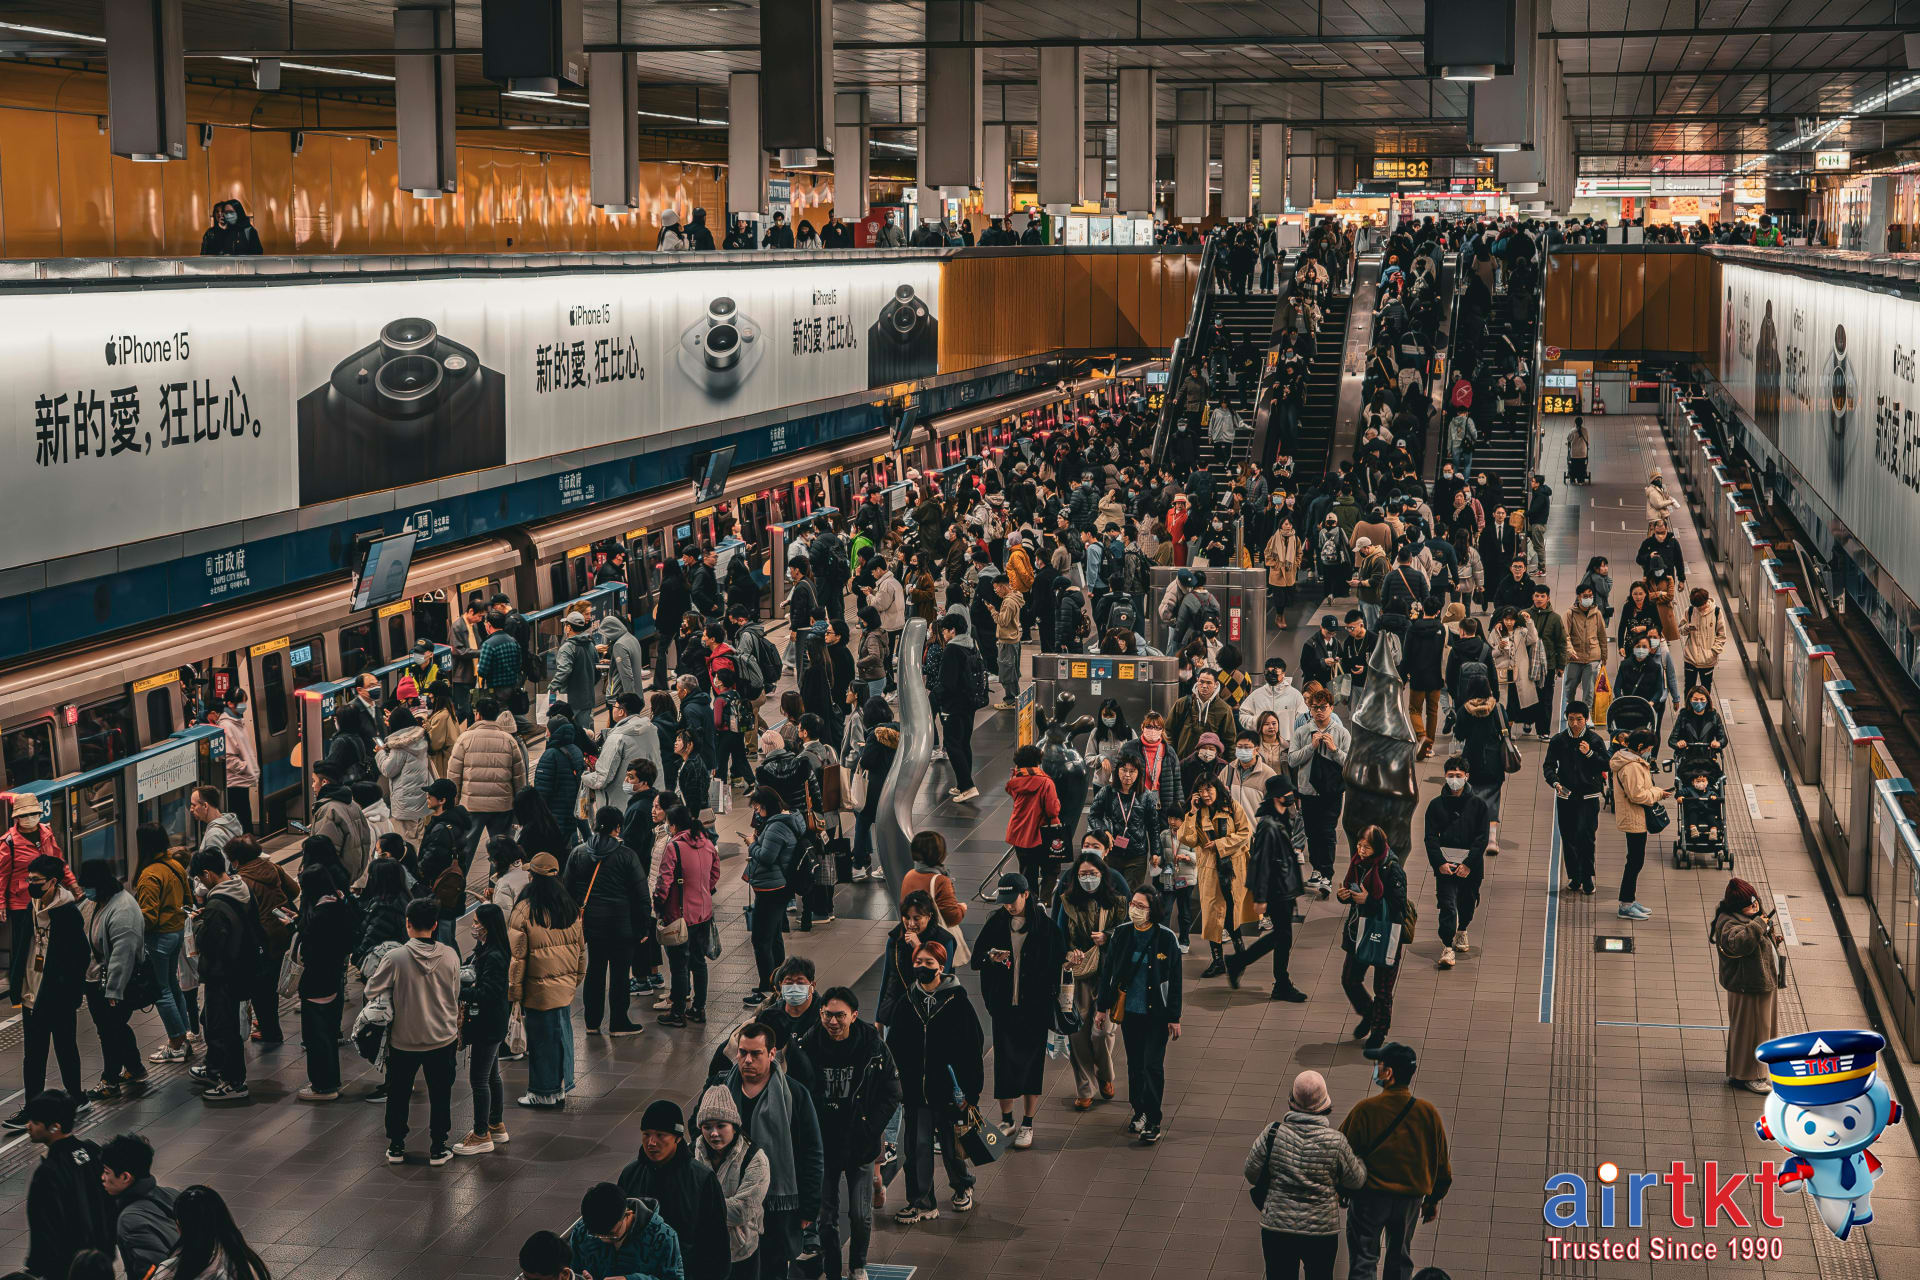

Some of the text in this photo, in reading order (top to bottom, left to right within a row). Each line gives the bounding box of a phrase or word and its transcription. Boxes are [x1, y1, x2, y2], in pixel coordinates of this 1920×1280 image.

[1407, 163, 1417, 178] 3
[1484, 178, 1491, 188] 4
[575, 303, 610, 326] iPhone 15
[118, 332, 190, 365] iPhone 15
[564, 471, 582, 490] 市政府
[214, 548, 246, 575] 市政府
[226, 572, 236, 582] CITY
[447, 654, 452, 666] 3
[329, 697, 335, 711] 3
[219, 736, 225, 752] 3
[45, 799, 51, 817] 3
